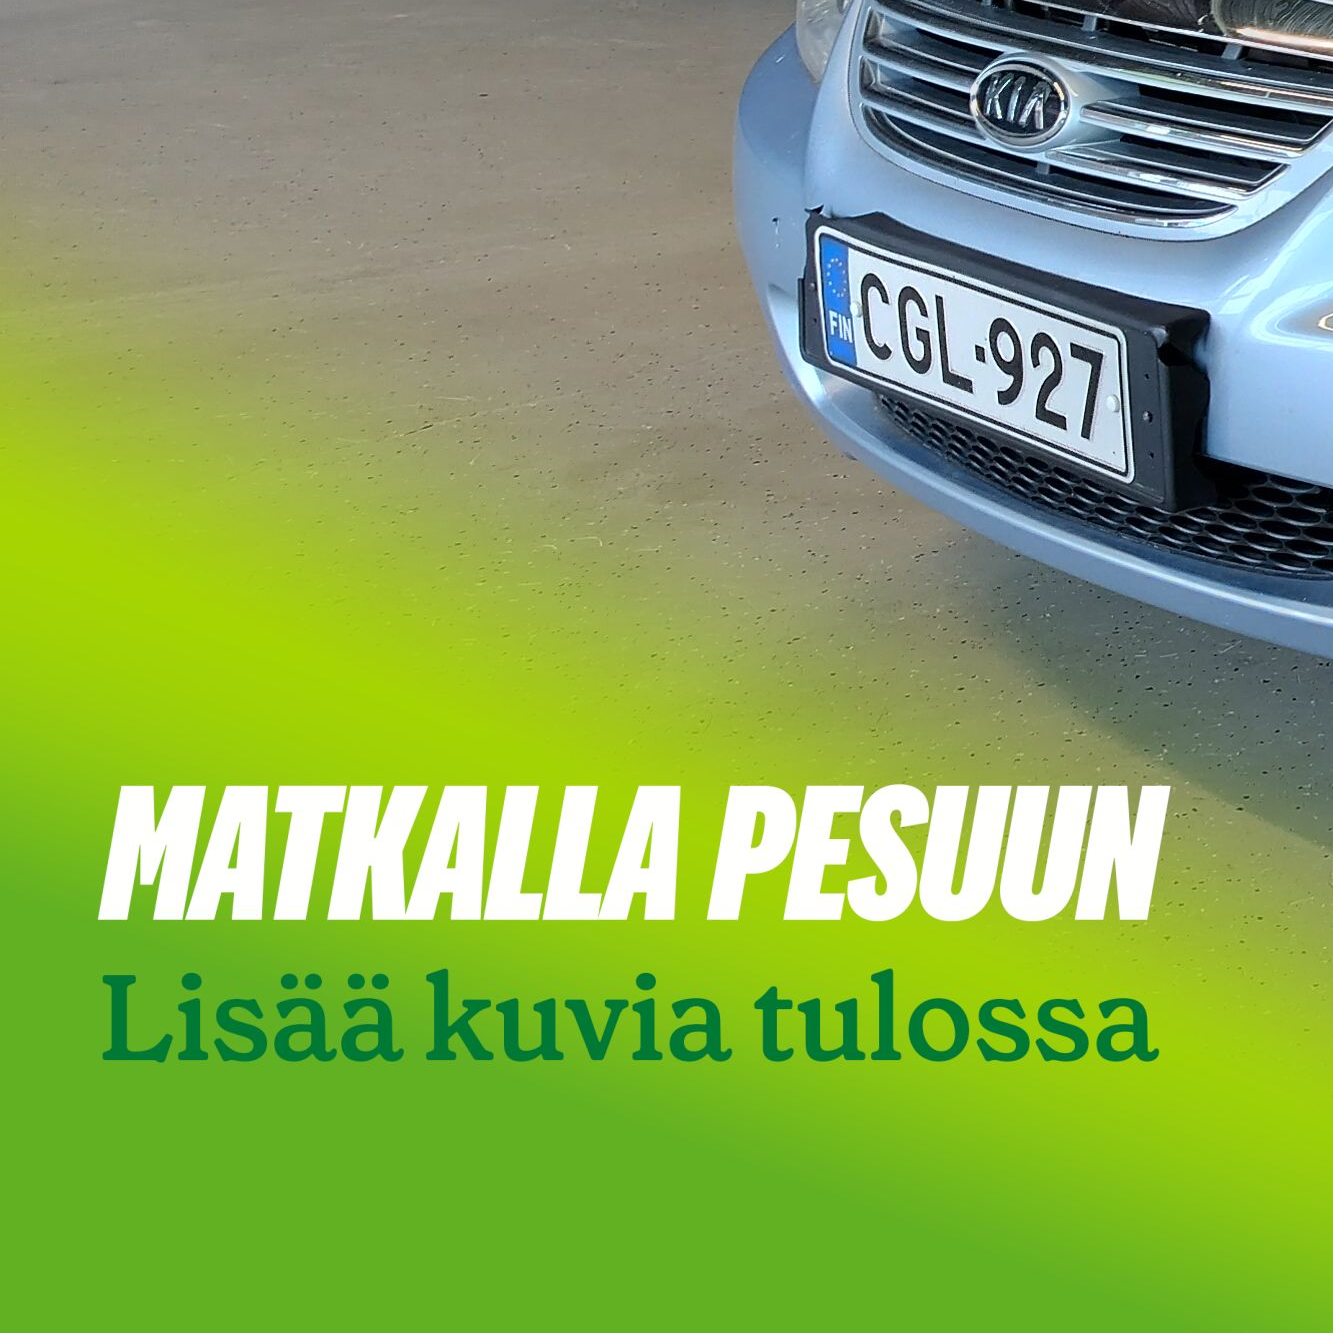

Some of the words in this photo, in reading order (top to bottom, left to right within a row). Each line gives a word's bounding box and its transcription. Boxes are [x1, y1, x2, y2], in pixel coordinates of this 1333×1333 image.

[983, 71, 1053, 130] KIA
[829, 310, 854, 344] FIN
[860, 272, 1104, 441] CGL-927
